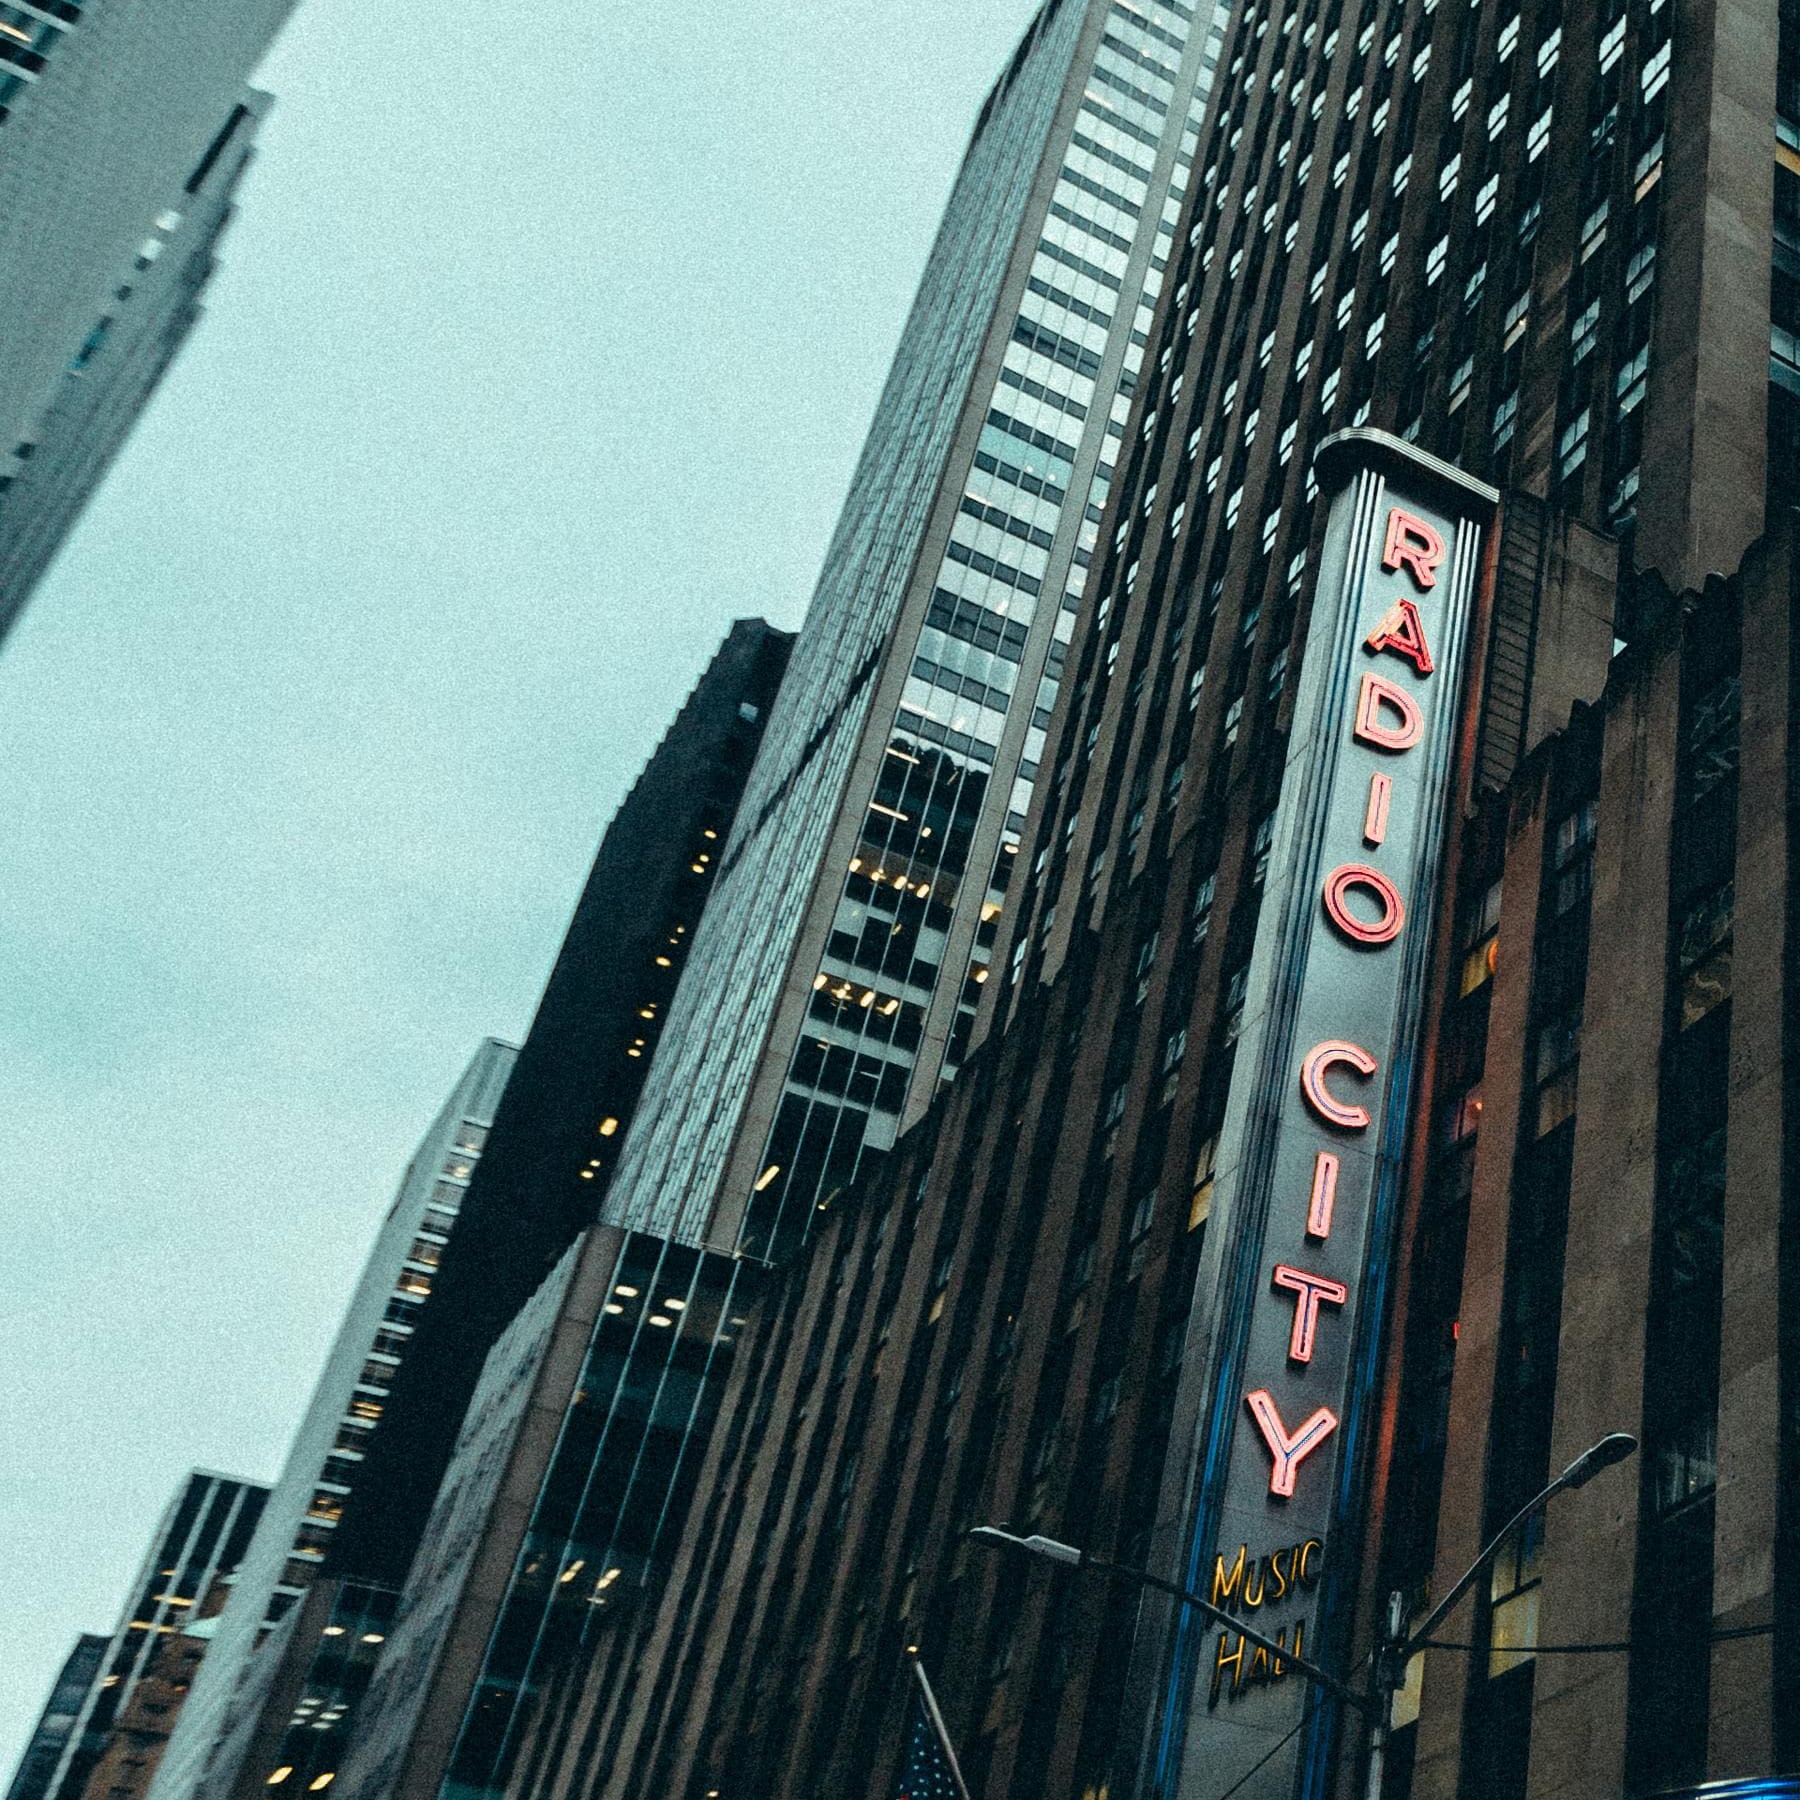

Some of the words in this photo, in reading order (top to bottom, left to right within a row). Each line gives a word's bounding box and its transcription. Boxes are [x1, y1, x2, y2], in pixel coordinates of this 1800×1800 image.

[1323, 507, 1445, 944] RADIO
[1247, 1039, 1379, 1498] CITY
[1211, 1539, 1321, 1608] MUSIC
